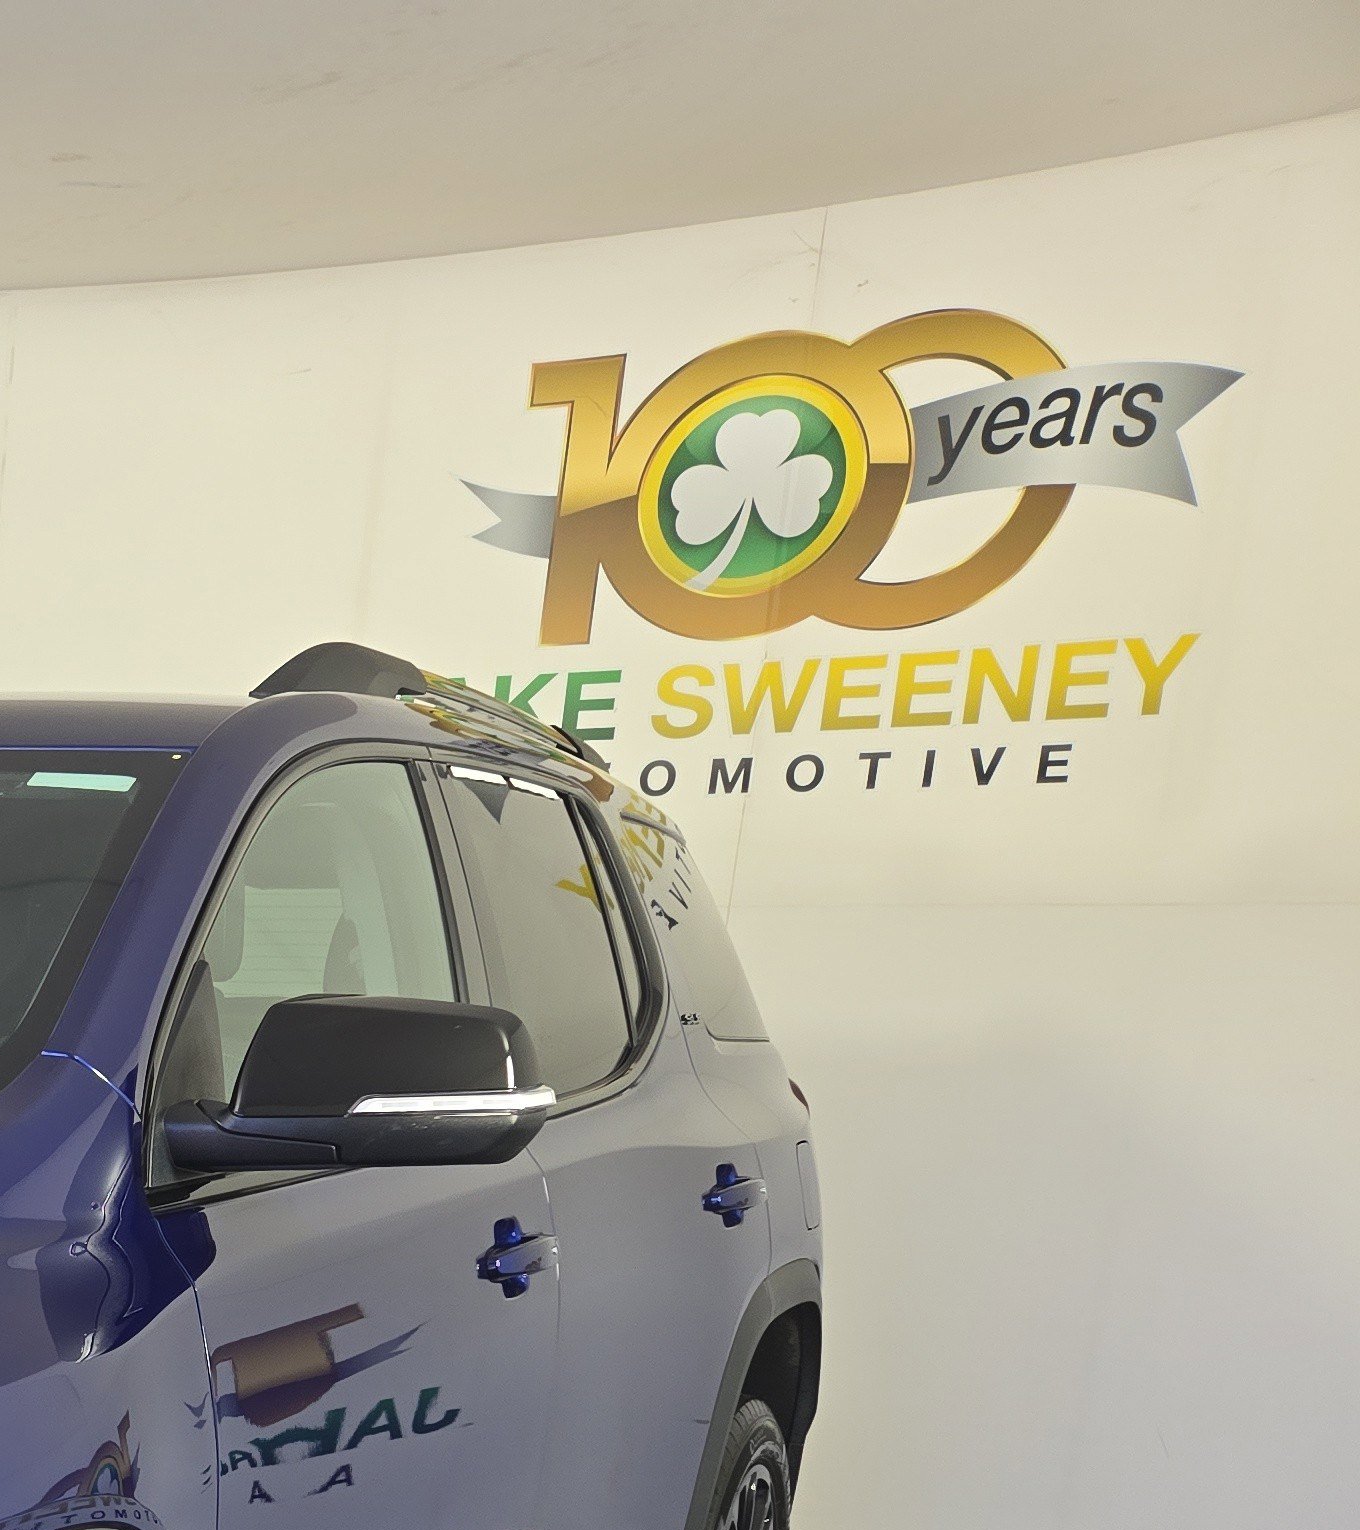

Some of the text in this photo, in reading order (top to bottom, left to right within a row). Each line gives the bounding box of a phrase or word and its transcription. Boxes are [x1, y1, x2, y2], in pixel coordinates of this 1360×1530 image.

[529, 308, 1163, 646] 100 years
[448, 632, 1201, 742] KE SWEENEY
[608, 742, 1074, 797] OMOTIVE
